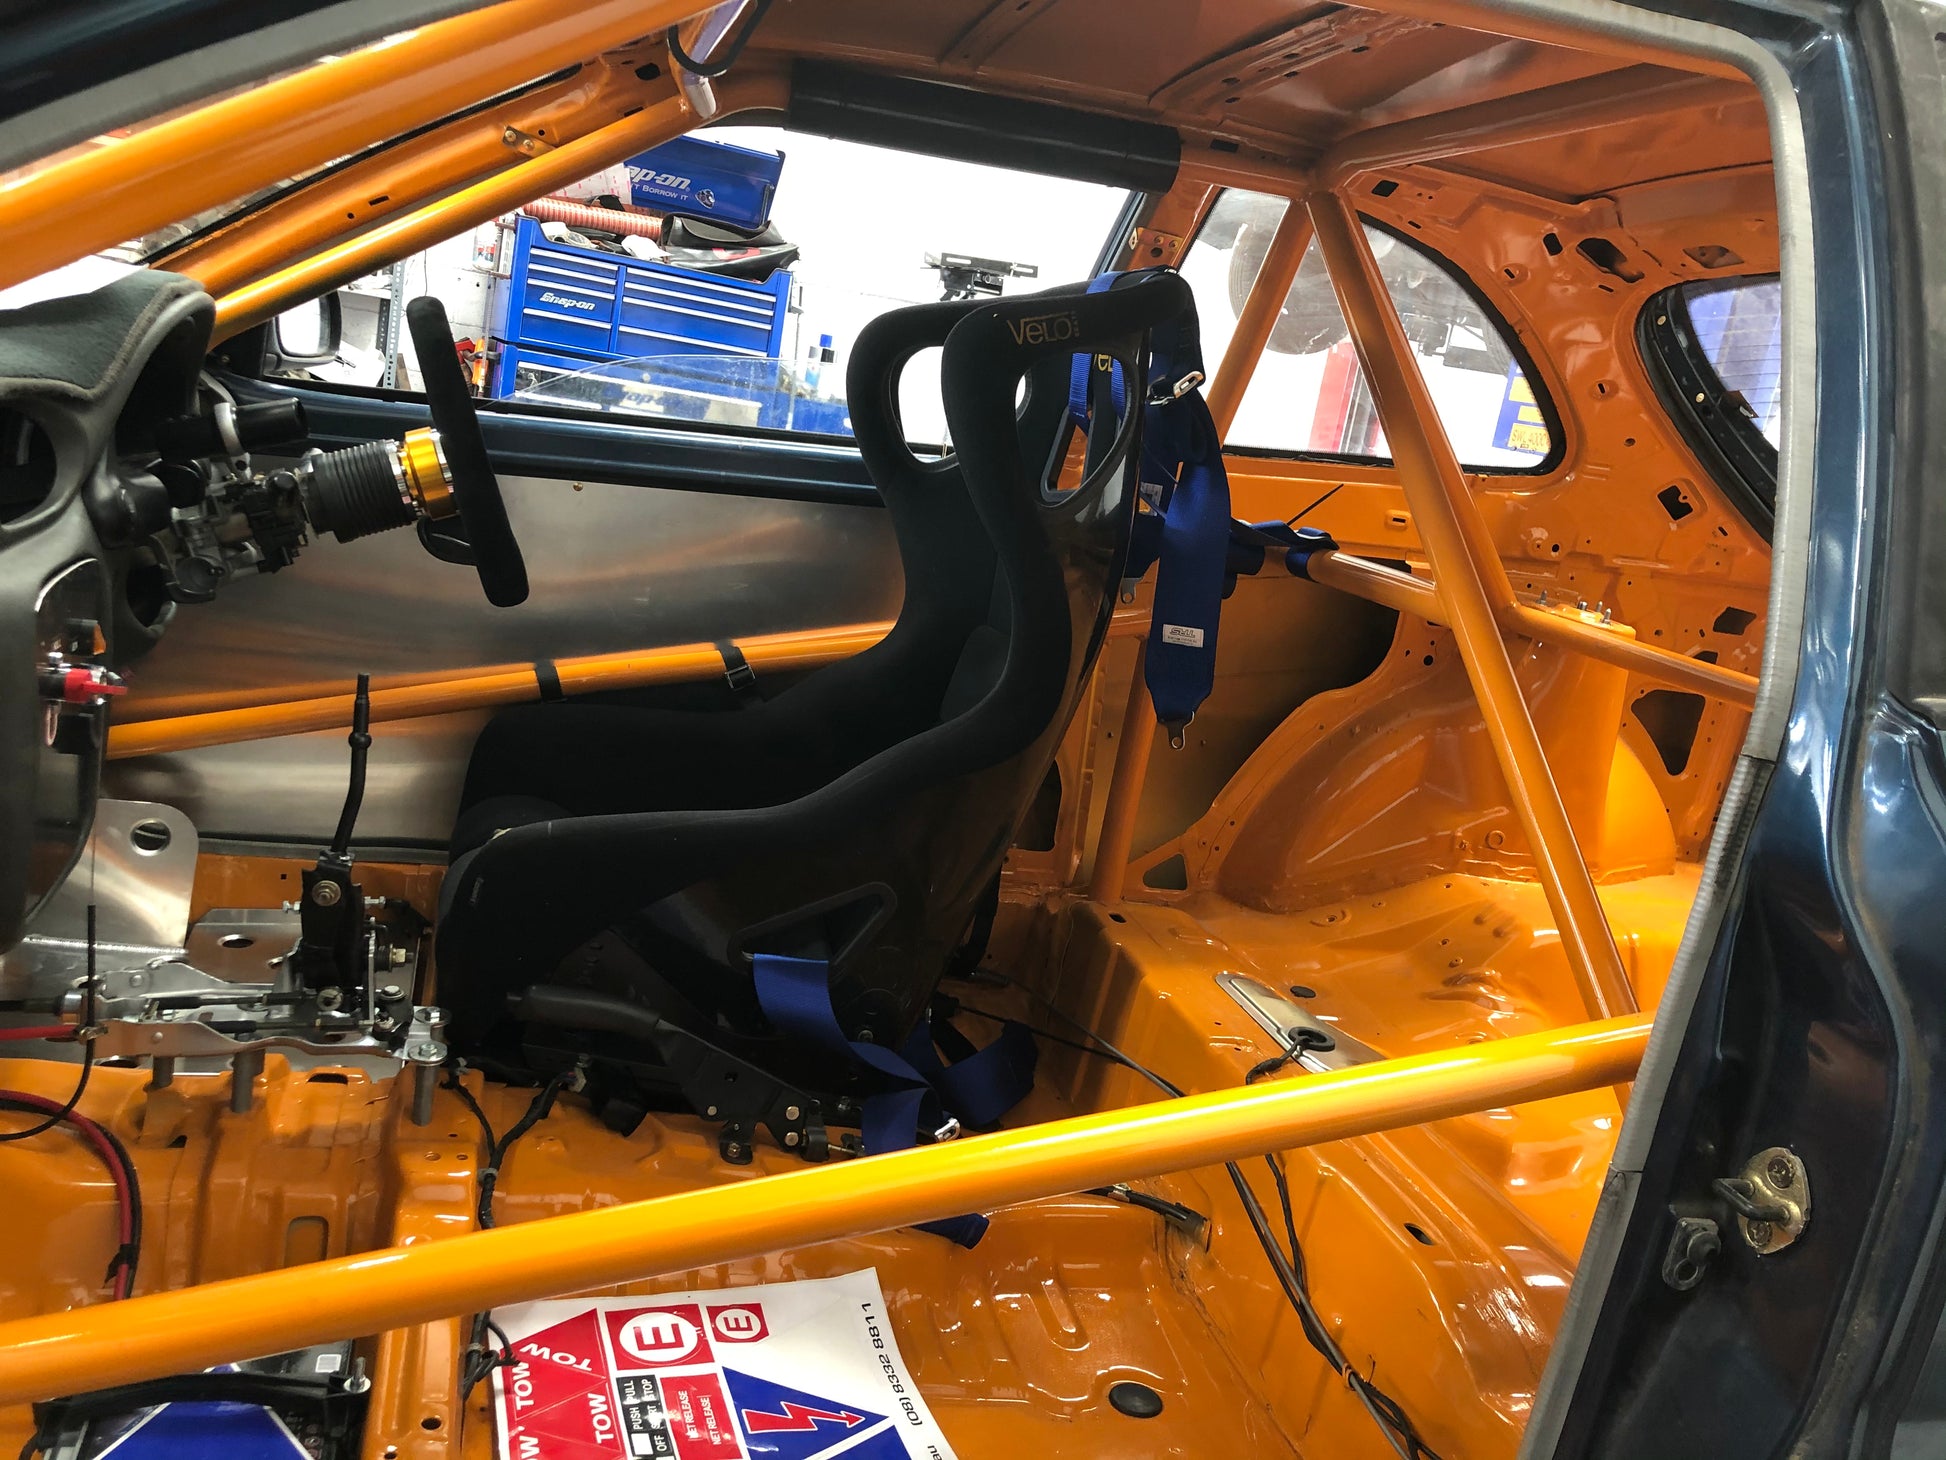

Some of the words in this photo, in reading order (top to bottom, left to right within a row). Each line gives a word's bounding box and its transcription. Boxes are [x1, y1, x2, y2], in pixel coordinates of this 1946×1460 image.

[540, 292, 596, 310] Snap-on
[633, 1323, 685, 1352] E
[723, 1315, 753, 1331] E
[862, 1302, 884, 1349] 8811
[519, 1343, 593, 1372] TOW
[512, 1362, 535, 1411] TOW
[879, 1354, 905, 1393] 8332
[624, 1380, 636, 1402] PULL
[641, 1379, 656, 1401] STOP
[587, 1393, 615, 1444] TOW
[629, 1406, 643, 1430] PUSH
[678, 1390, 694, 1423] RELEASE
[700, 1397, 717, 1429] RELEASE
[899, 1397, 923, 1426] (08)
[654, 1435, 667, 1452] OFF
[686, 1424, 699, 1439] ET
[710, 1430, 722, 1445] NET
